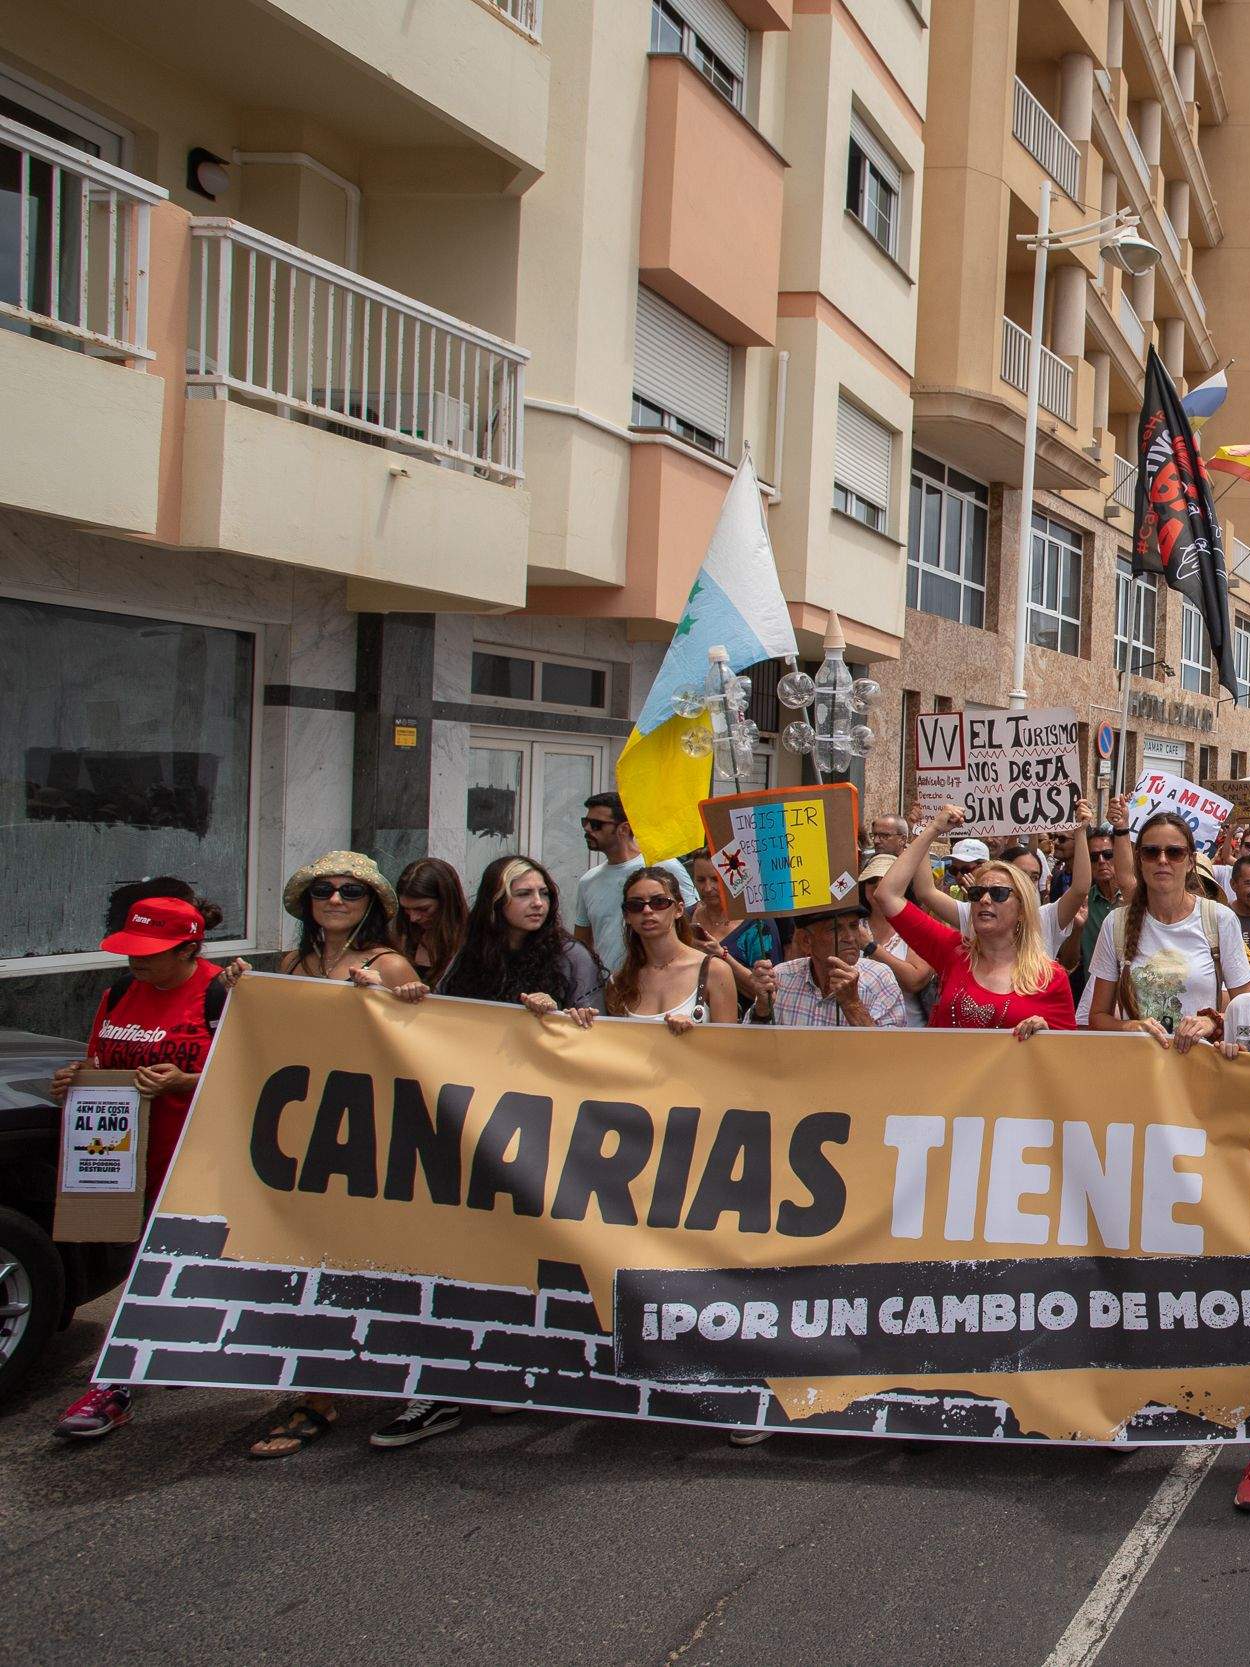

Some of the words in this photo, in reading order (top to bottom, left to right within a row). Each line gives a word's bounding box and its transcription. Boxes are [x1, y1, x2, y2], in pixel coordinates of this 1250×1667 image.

[970, 720, 1002, 749] EL
[1006, 715, 1079, 748] TURISMO
[967, 762, 999, 783] NOS
[1008, 755, 1070, 783] DEJA
[964, 793, 1004, 824] SIN
[1010, 783, 1082, 825] CASA
[1167, 789, 1176, 800] A
[1178, 788, 1200, 808] MI
[1200, 798, 1228, 822] ISLA
[736, 806, 818, 831] INSISTIR
[740, 833, 796, 855] RESISTIR
[771, 855, 803, 872] NUNCA
[745, 878, 812, 905] DESISTIR
[75, 1116, 93, 1130] AL
[97, 1114, 129, 1131] AÑO
[77, 1105, 94, 1113] 4KM
[107, 1106, 130, 1114] COSTA
[250, 1065, 852, 1237] CANARIAS
[883, 1115, 1207, 1256] TIENE
[642, 1301, 778, 1341] ¡POR
[791, 1298, 868, 1338] UN
[878, 1290, 1078, 1335] CAMBIO
[1089, 1289, 1149, 1330] DE
